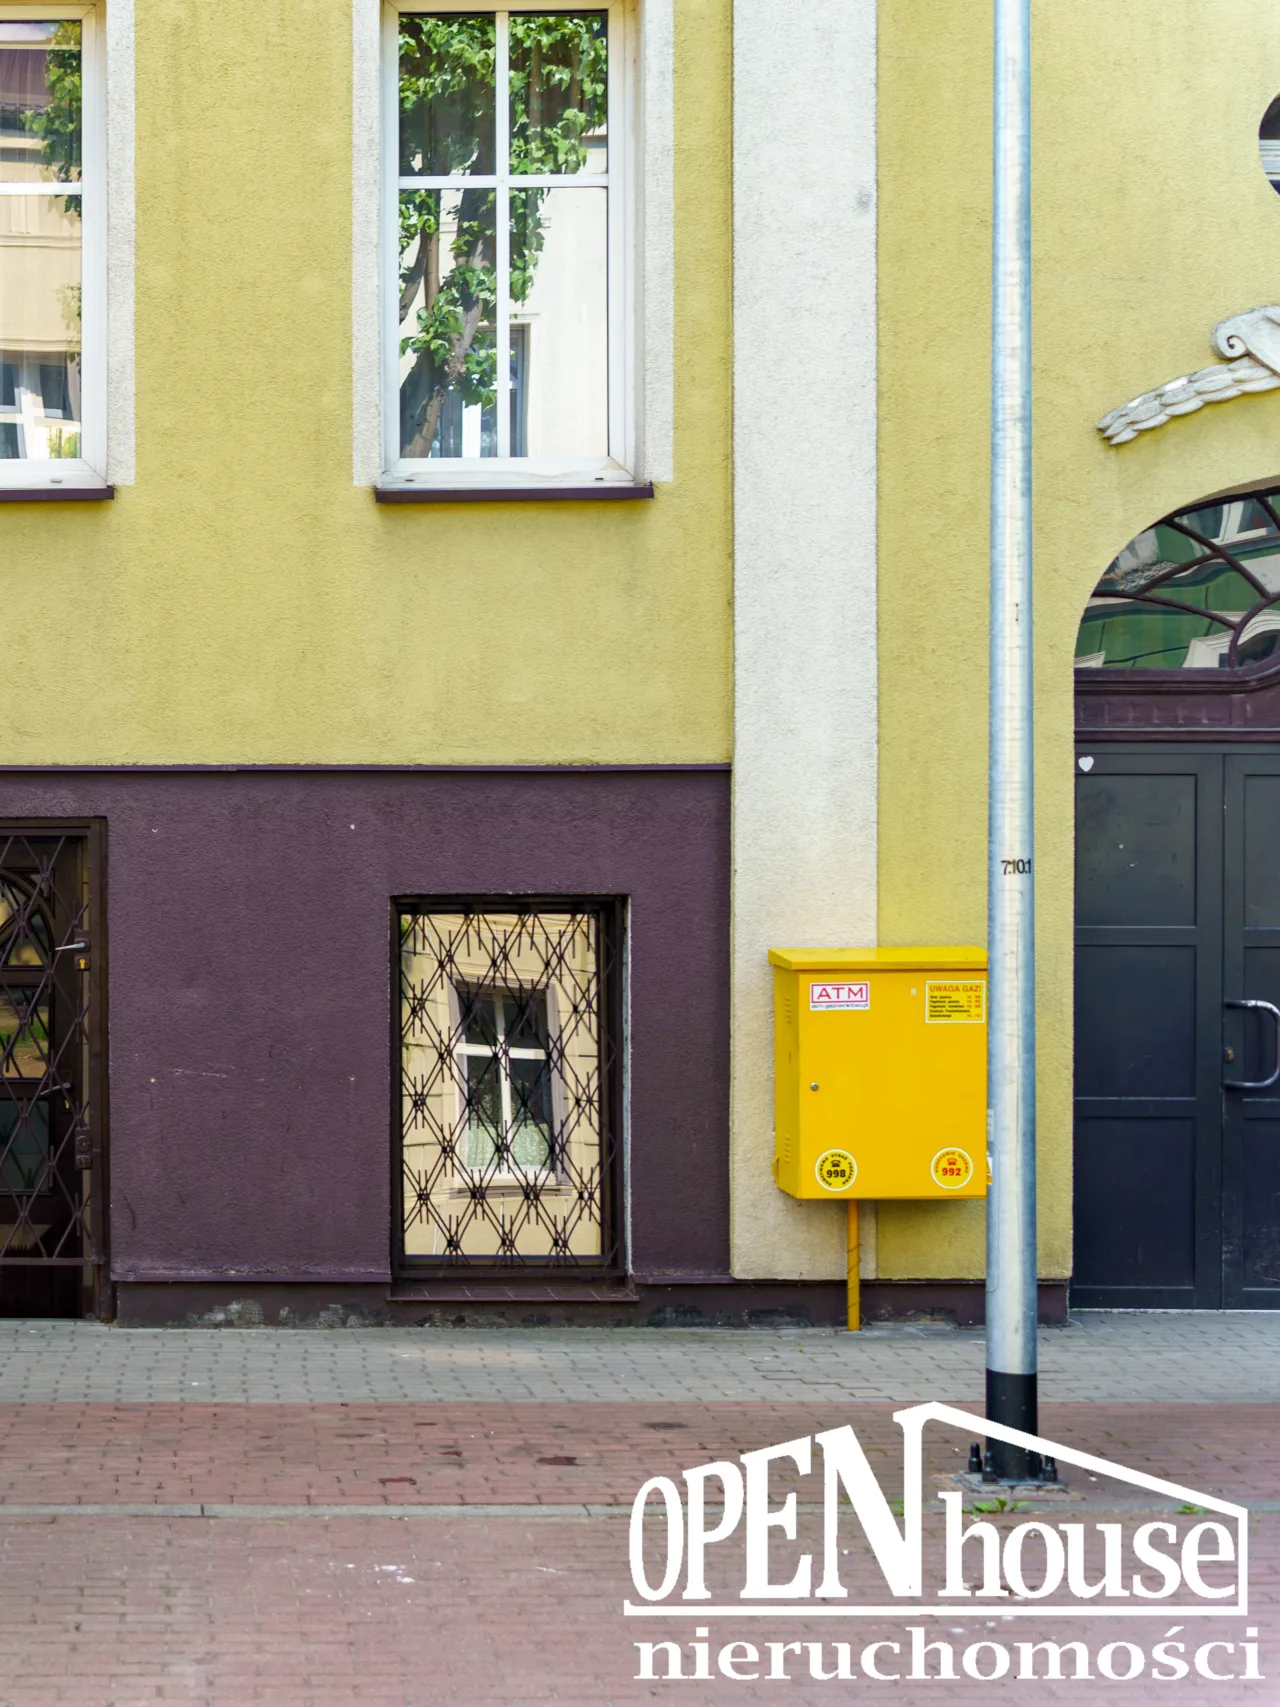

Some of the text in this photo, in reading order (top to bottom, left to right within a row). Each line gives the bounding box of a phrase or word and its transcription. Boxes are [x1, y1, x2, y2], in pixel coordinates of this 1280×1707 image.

[929, 984, 960, 992] UWAGA
[816, 986, 864, 1000] ATM
[826, 1169, 846, 1178] 998
[942, 1167, 961, 1176] 992
